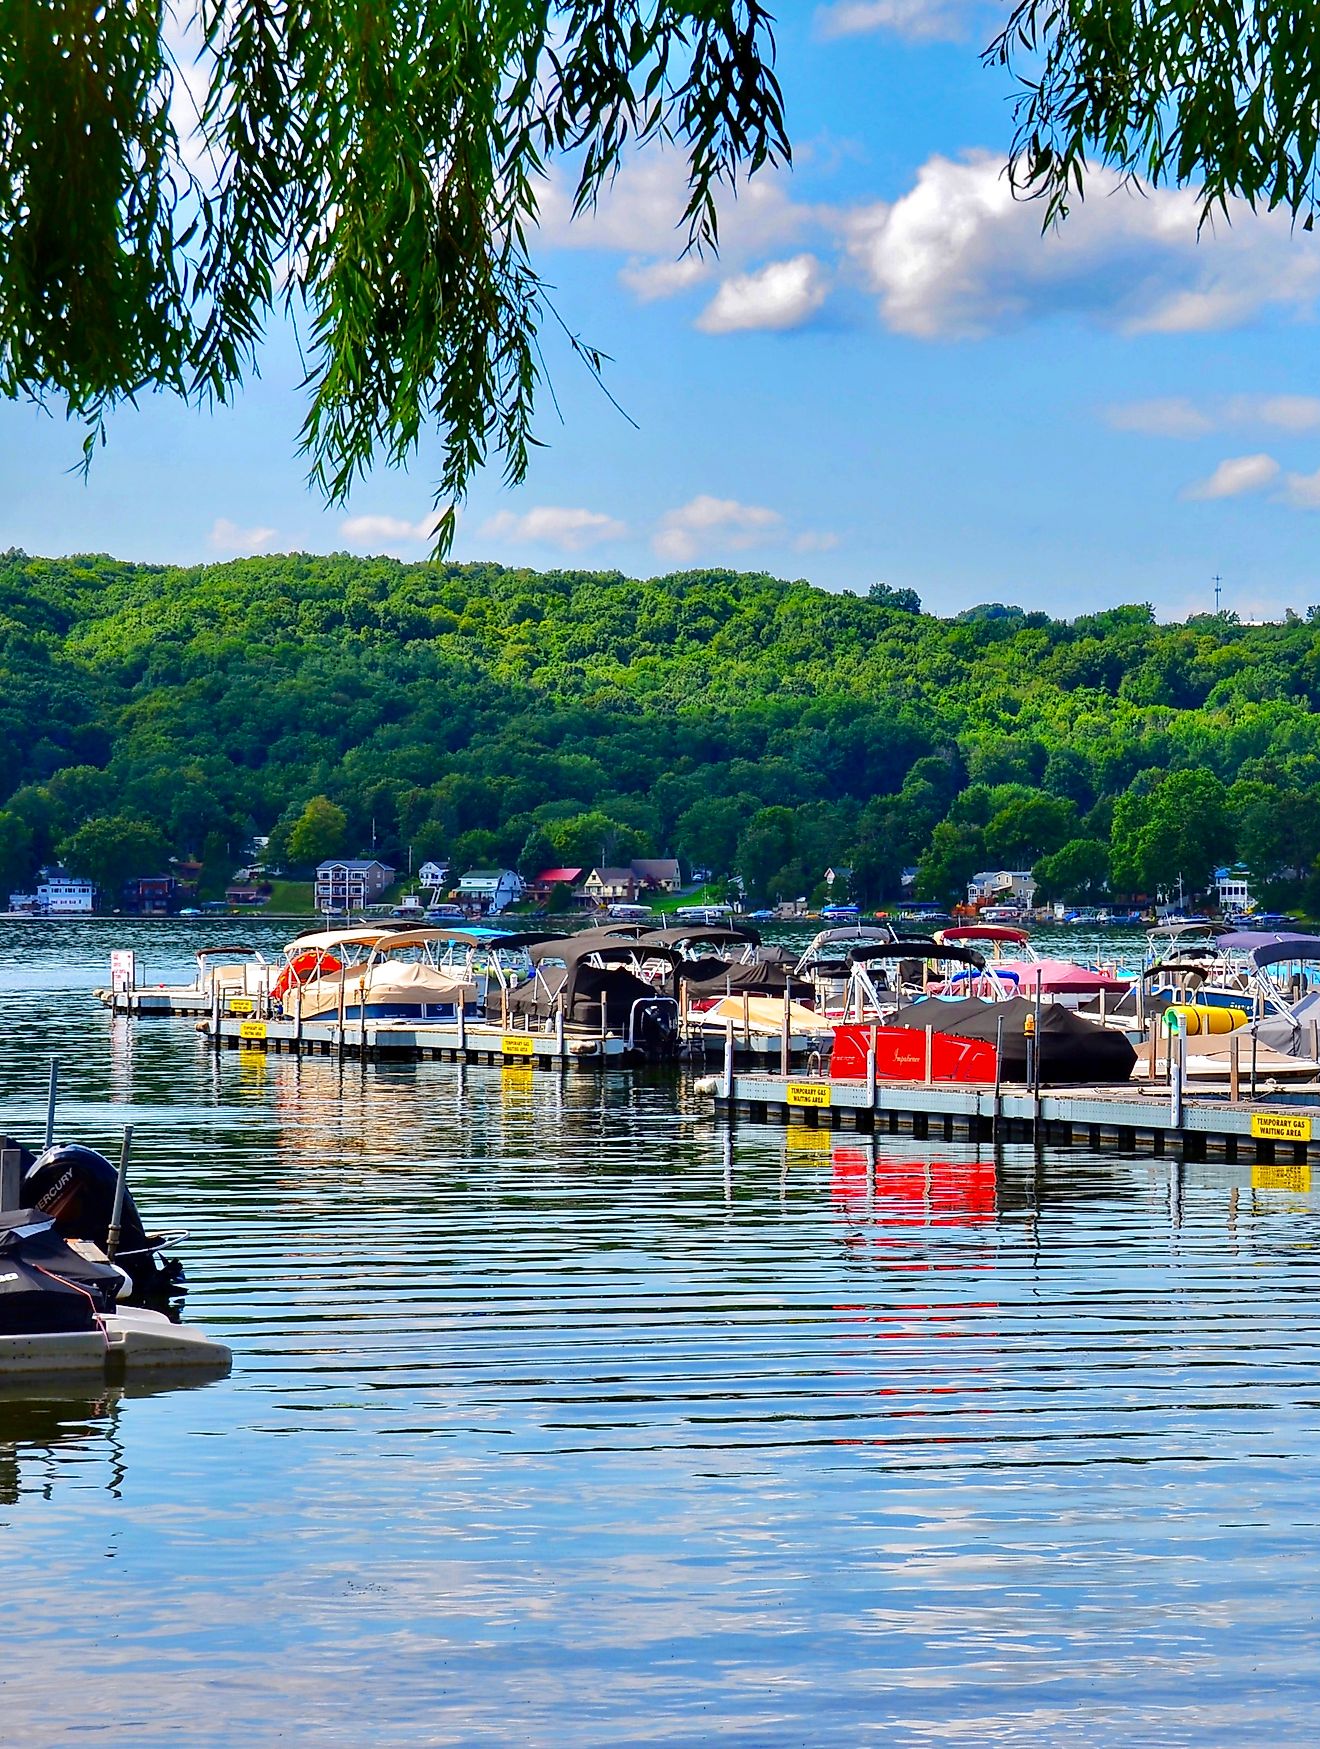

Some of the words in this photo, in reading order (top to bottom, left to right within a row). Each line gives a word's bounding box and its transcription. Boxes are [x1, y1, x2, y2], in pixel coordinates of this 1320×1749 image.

[791, 1088, 816, 1096] TEMPORARY
[1257, 1118, 1292, 1127] TEMPORARY
[1293, 1120, 1305, 1128] GAS
[1260, 1127, 1285, 1136] WAITING
[1286, 1129, 1302, 1137] AREA
